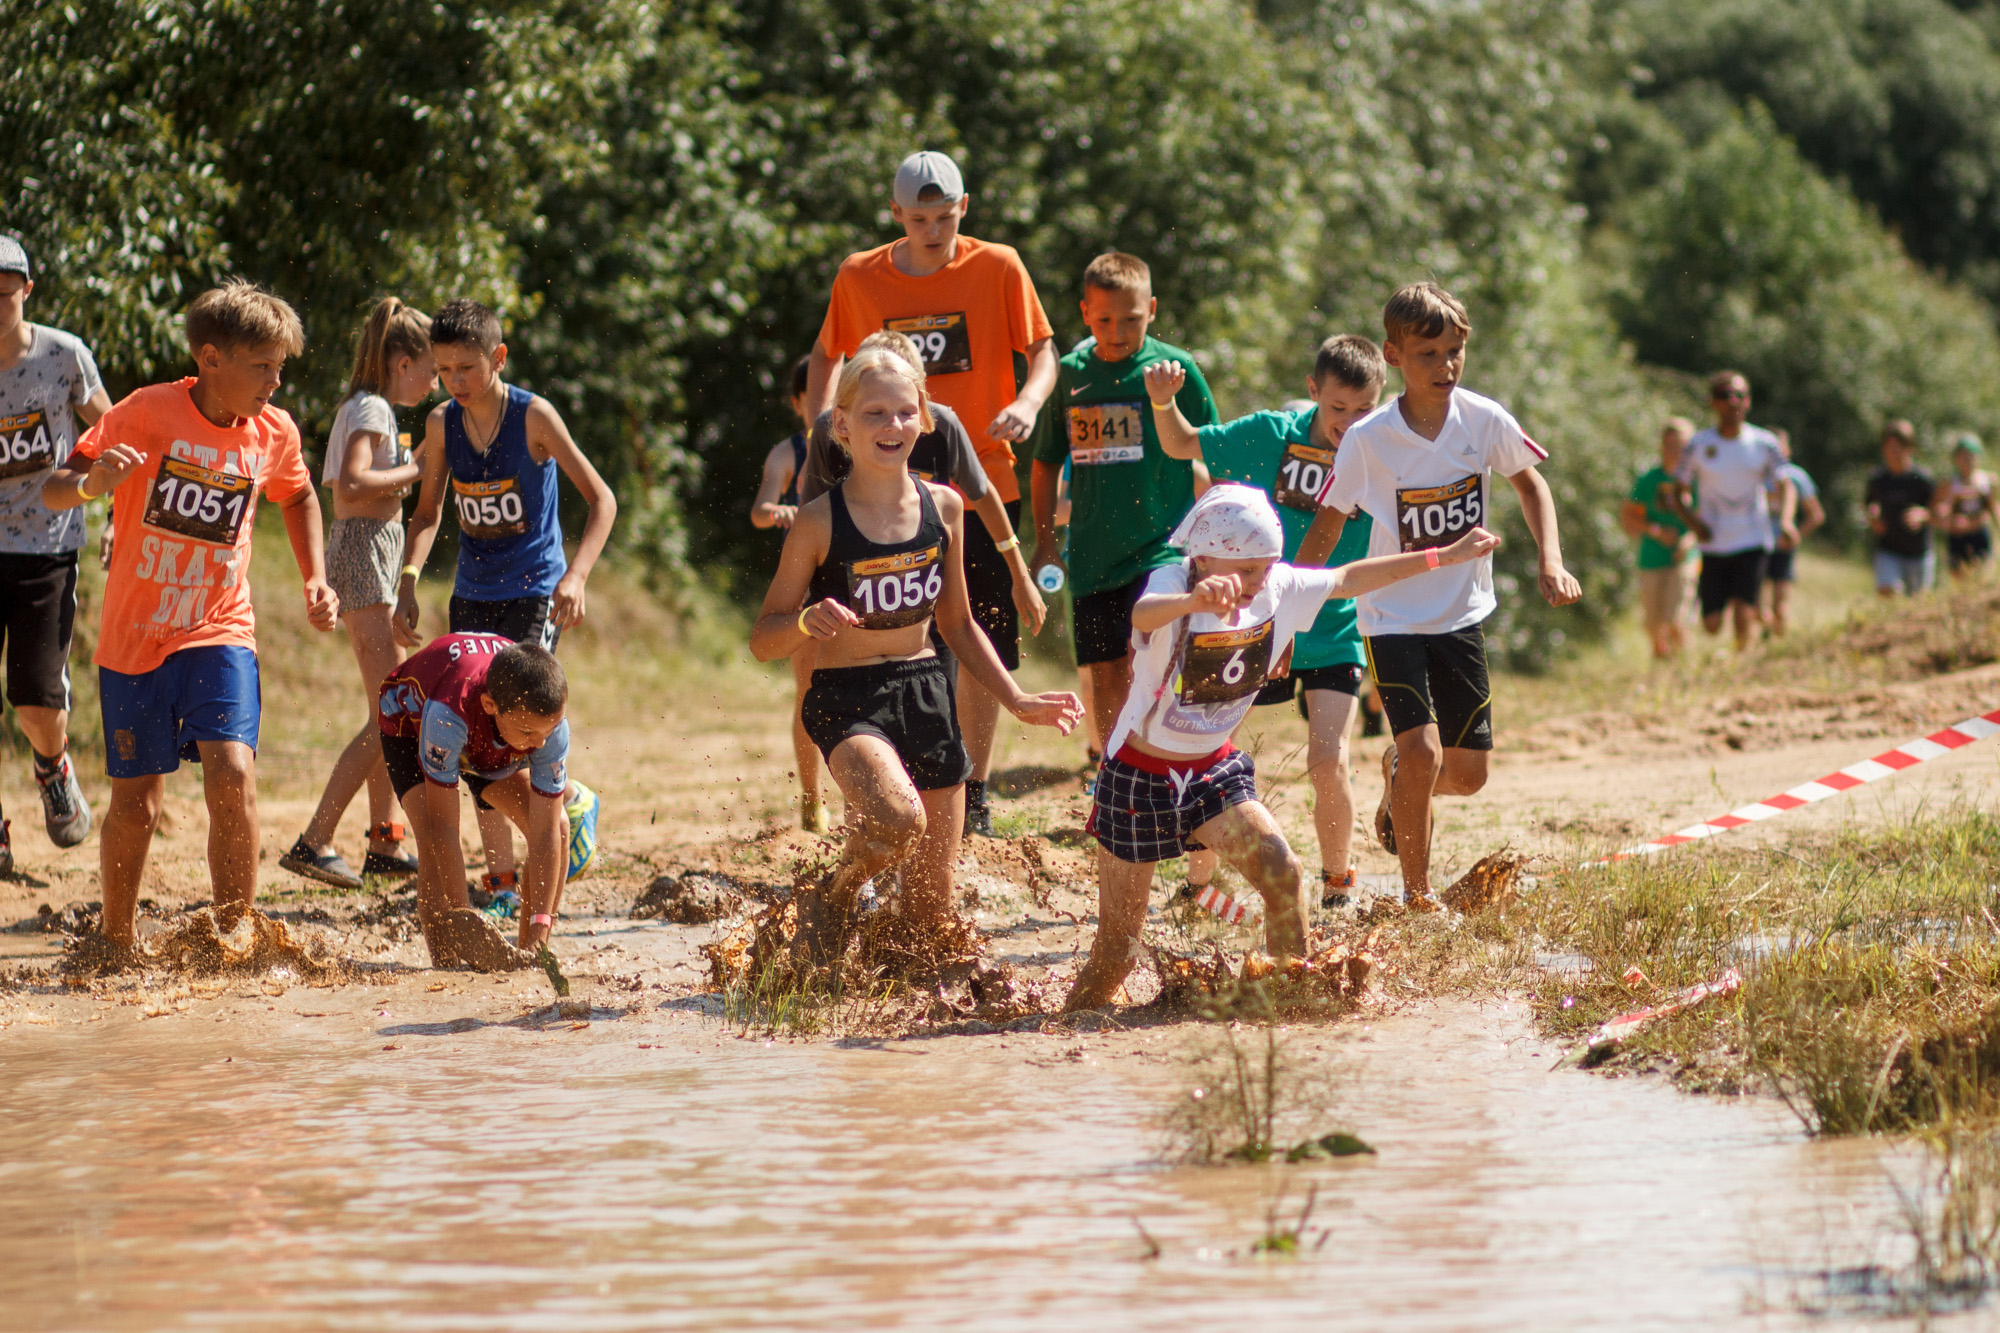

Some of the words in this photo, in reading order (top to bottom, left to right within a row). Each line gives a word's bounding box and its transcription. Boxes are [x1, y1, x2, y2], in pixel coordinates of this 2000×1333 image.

[1077, 416, 1129, 441] 3141
[158, 477, 244, 527] 1051
[455, 492, 523, 525] 1050
[1402, 491, 1482, 539] 1055
[854, 563, 942, 614] 1056
[449, 639, 515, 661] VIES
[1222, 648, 1245, 684] 6
